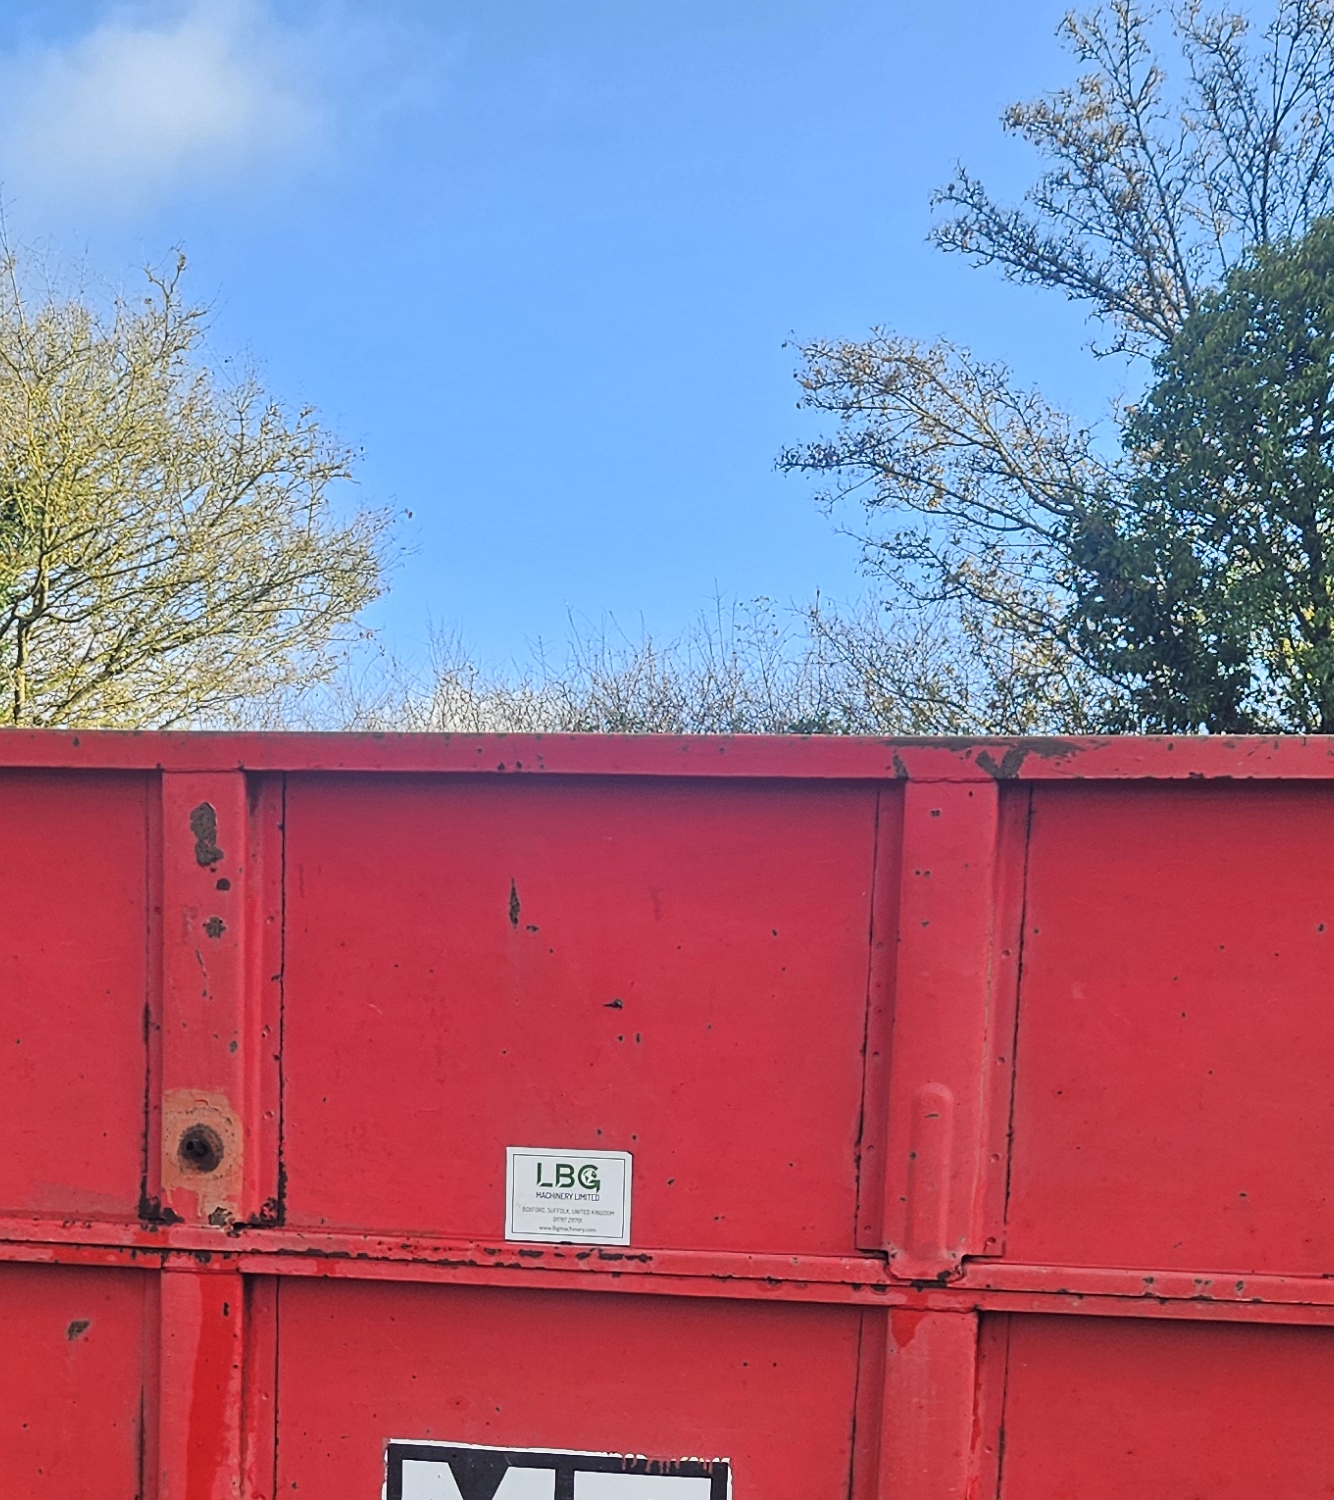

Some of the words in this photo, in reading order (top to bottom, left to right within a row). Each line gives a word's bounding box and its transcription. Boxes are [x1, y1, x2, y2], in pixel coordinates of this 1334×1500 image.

[537, 1162, 601, 1193] LBG
[536, 1191, 573, 1200] MACHINERY
[575, 1193, 600, 1202] LIMITED
